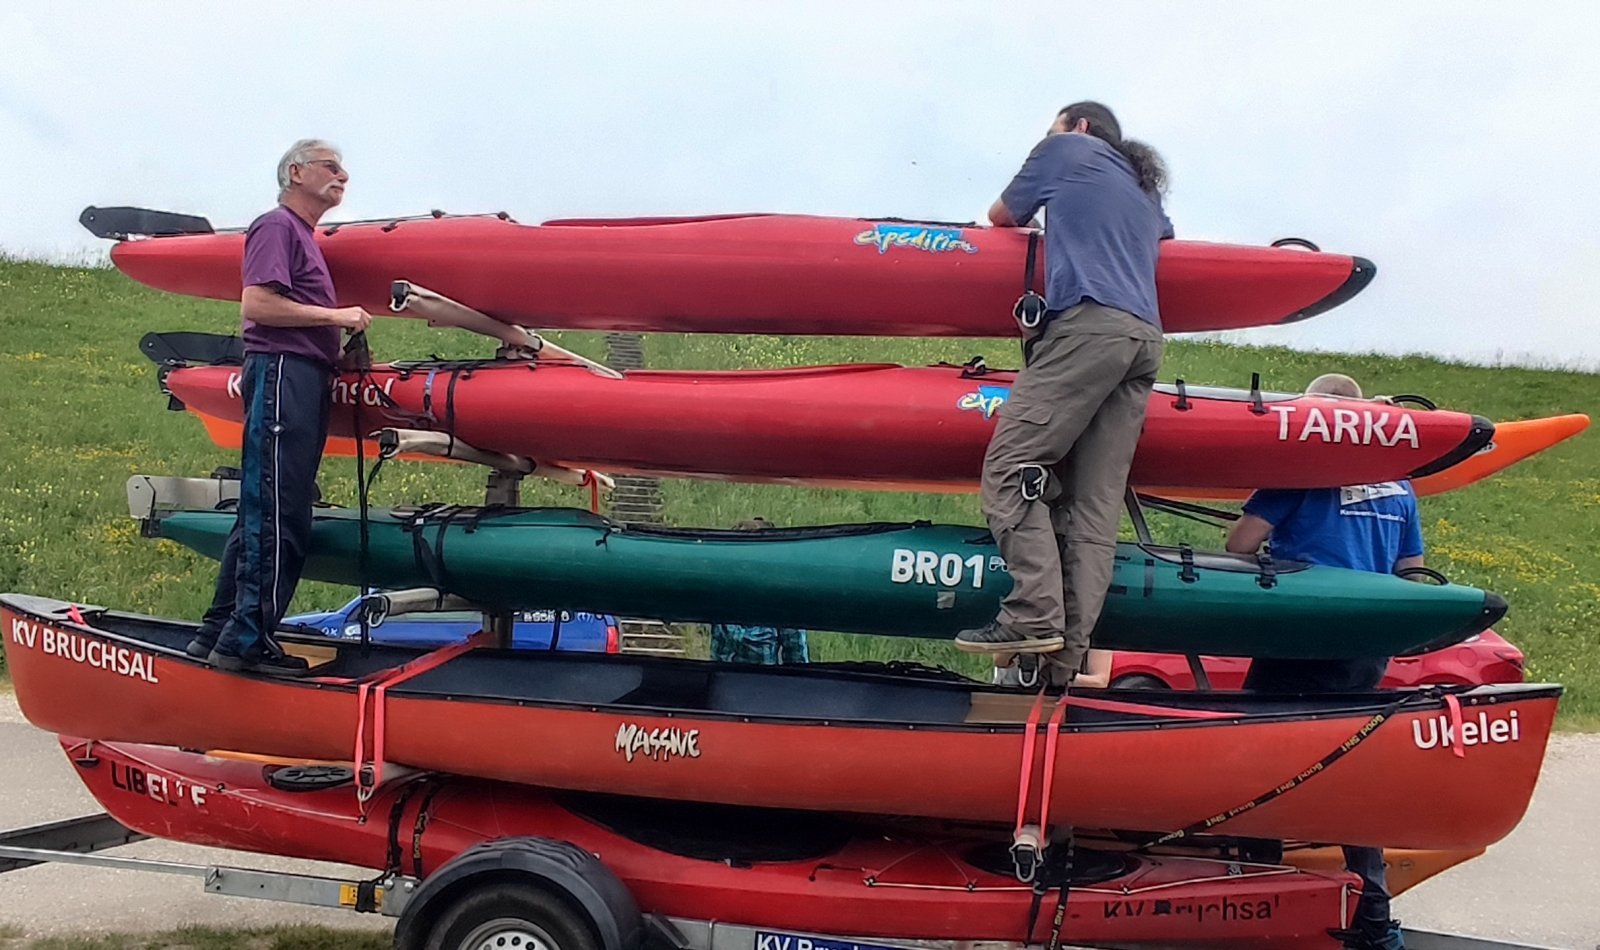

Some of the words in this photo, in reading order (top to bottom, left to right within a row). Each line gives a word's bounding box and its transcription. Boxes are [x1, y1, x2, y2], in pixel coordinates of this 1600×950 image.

[854, 228, 978, 254] expedition
[957, 393, 1004, 419] exp
[1269, 405, 1419, 449] TARKA
[891, 549, 985, 588] BR01
[12, 618, 38, 648] KV
[42, 627, 159, 684] BRUCHSAL
[1411, 709, 1519, 749] Ukelei
